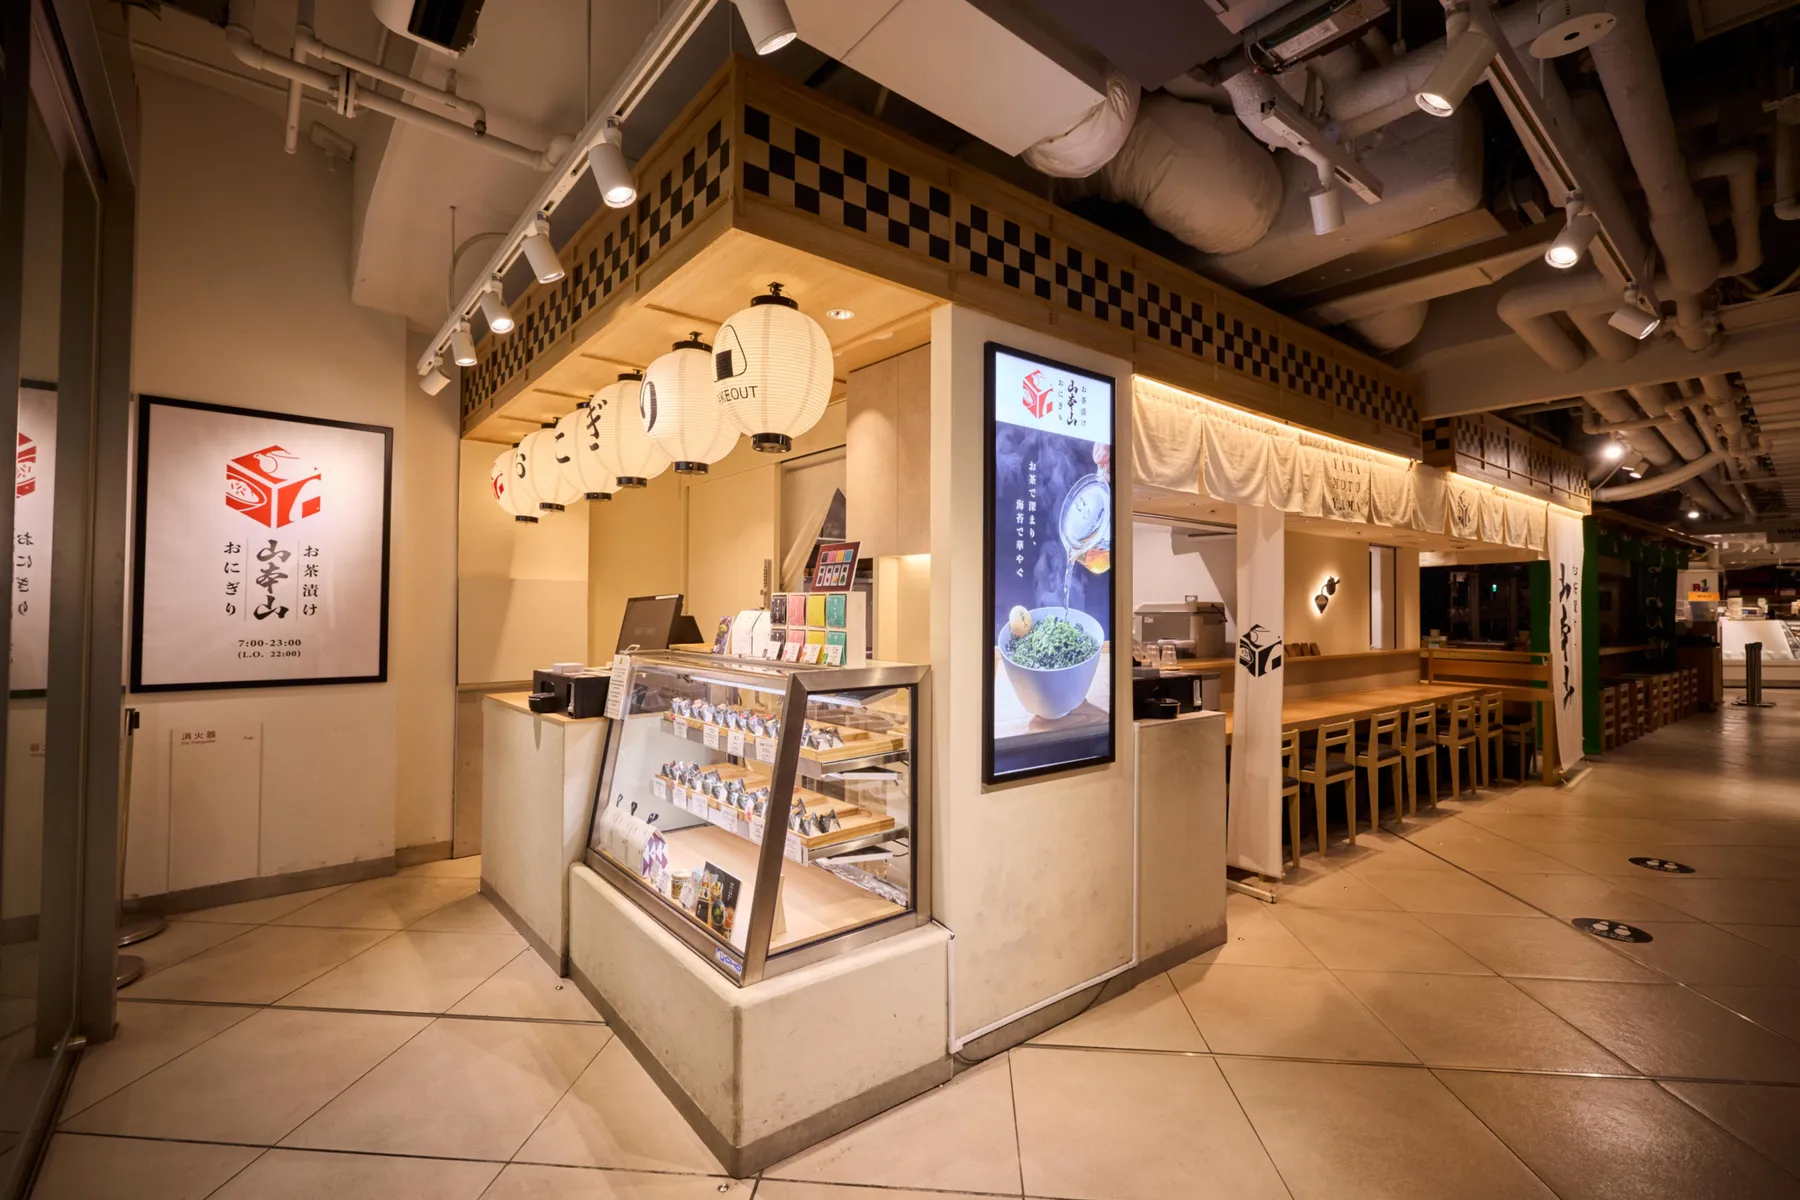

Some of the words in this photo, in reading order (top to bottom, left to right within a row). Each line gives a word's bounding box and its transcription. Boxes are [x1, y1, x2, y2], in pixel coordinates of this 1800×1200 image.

[1066, 380, 1078, 426] 山本山
[1333, 457, 1361, 475] YAMA
[1332, 477, 1361, 494] MOTO
[1028, 461, 1037, 546] お茶で深まり、
[1332, 497, 1361, 513] YAMA
[1015, 499, 1025, 578] 海苔で華やぐ
[223, 541, 242, 616] おにぎり
[253, 539, 292, 621] 山本山
[302, 545, 320, 616] お茶漬け
[237, 650, 264, 660] (L.O.
[270, 650, 302, 659] 22:00)
[238, 639, 302, 648] 7:00-23:00
[181, 730, 216, 741] 消火器
